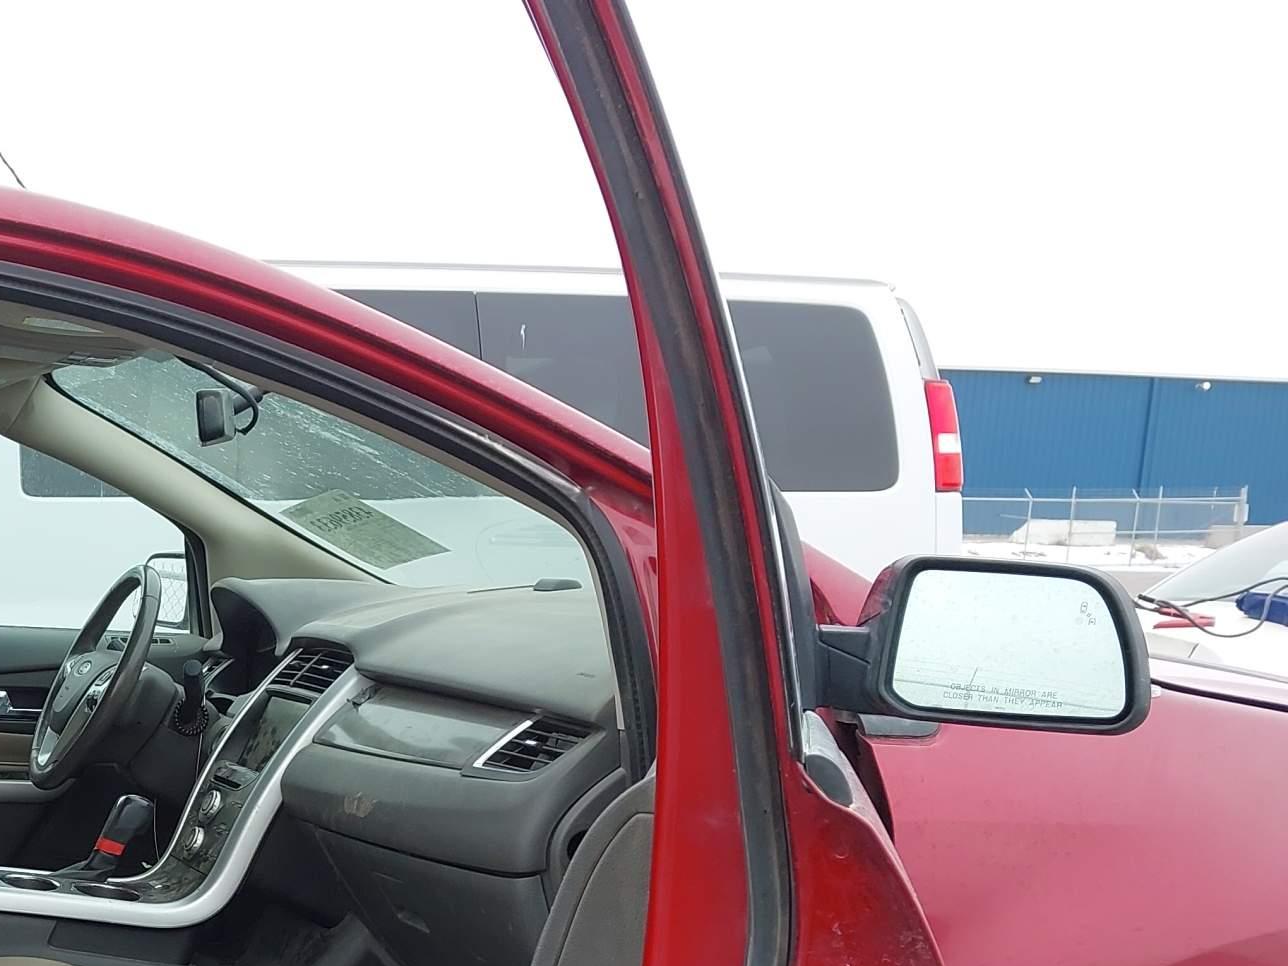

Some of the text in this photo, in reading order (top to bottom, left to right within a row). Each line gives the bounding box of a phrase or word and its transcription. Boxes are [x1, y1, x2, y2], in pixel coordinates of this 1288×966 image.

[943, 690, 1063, 710] CLOSER THAN THEY APPEAR
[951, 682, 1058, 700] OBJECTS IN MIRROR ARE
